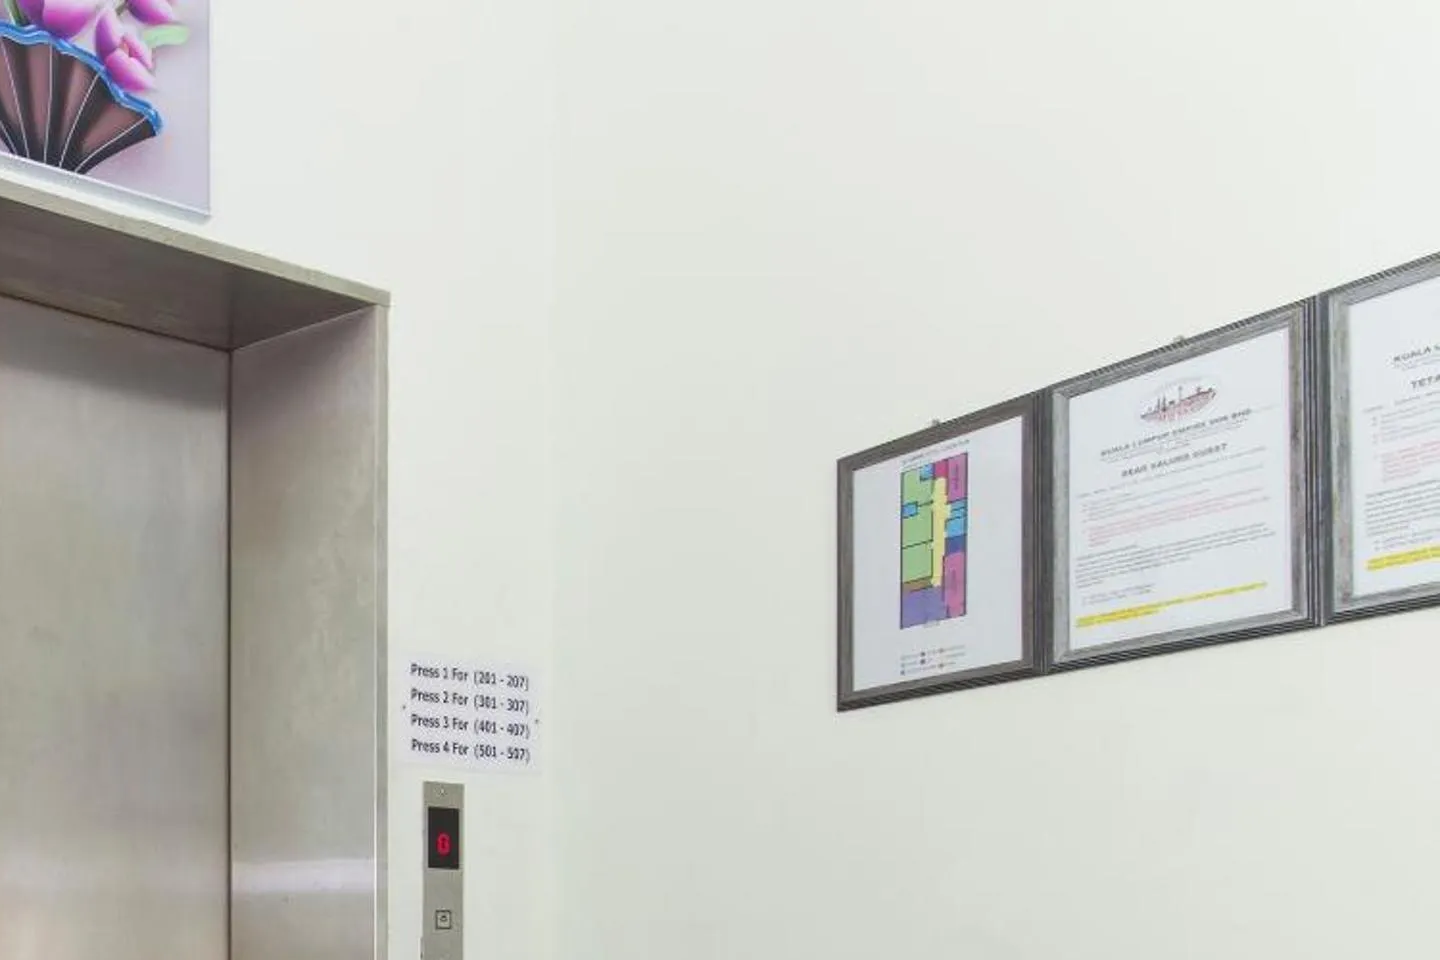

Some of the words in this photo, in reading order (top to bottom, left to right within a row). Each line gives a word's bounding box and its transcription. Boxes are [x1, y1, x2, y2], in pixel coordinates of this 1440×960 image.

[411, 663, 440, 679] Press
[443, 667, 448, 679] 1
[452, 667, 468, 681] For
[411, 687, 440, 703] Press
[443, 690, 449, 703] 2
[452, 692, 468, 705] For
[411, 713, 440, 728] Press
[443, 715, 449, 728] 3
[452, 717, 469, 730] For
[411, 738, 440, 753] Press
[443, 740, 450, 752] 4
[452, 742, 469, 755] For
